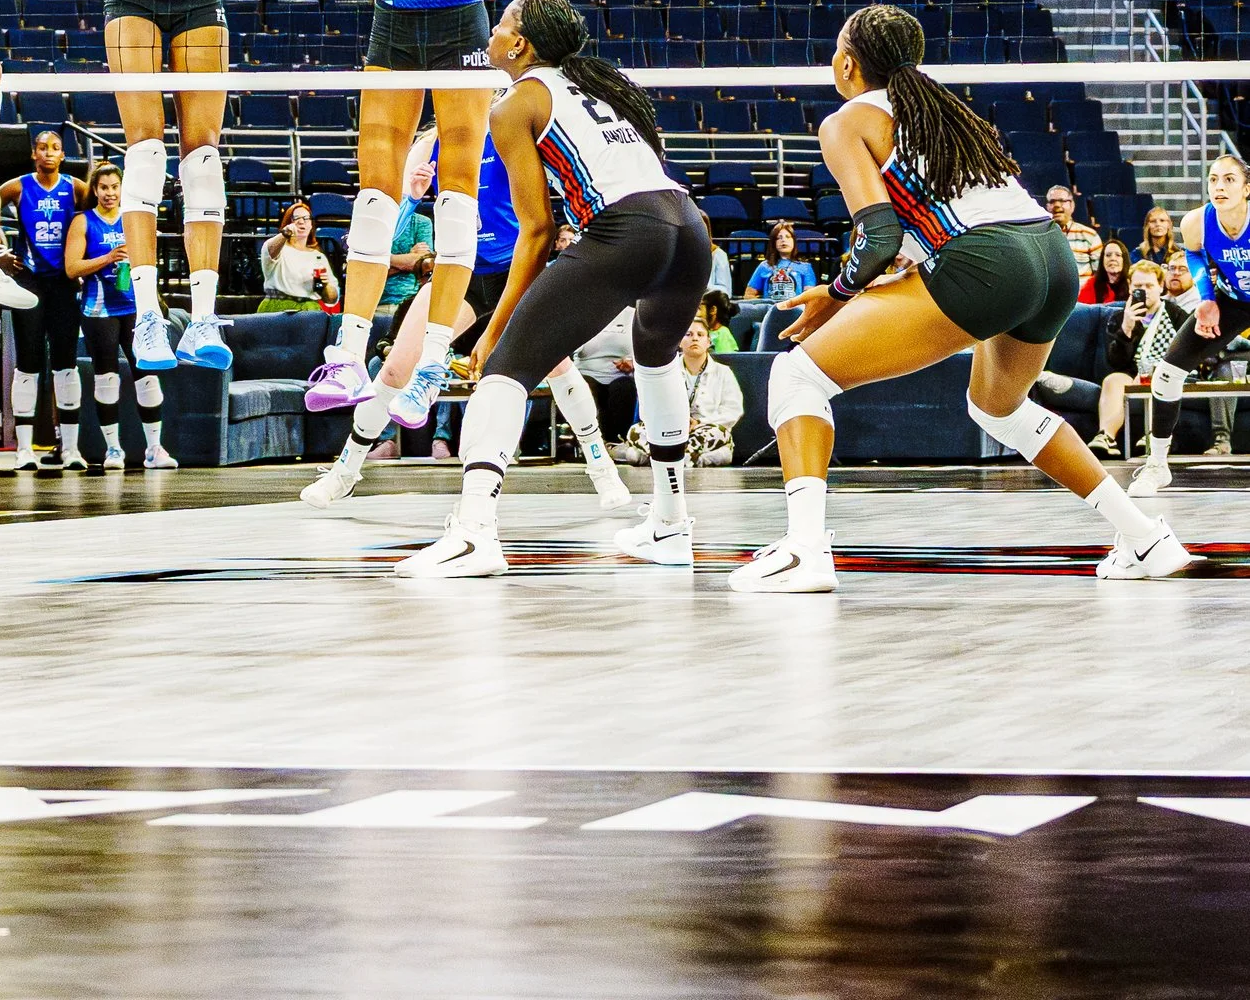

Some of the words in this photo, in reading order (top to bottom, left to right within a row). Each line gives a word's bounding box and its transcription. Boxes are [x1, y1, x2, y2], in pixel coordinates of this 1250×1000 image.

[462, 53, 491, 67] PULS
[38, 200, 60, 210] PULSE
[35, 222, 63, 242] 23
[1222, 249, 1250, 261] PULS
